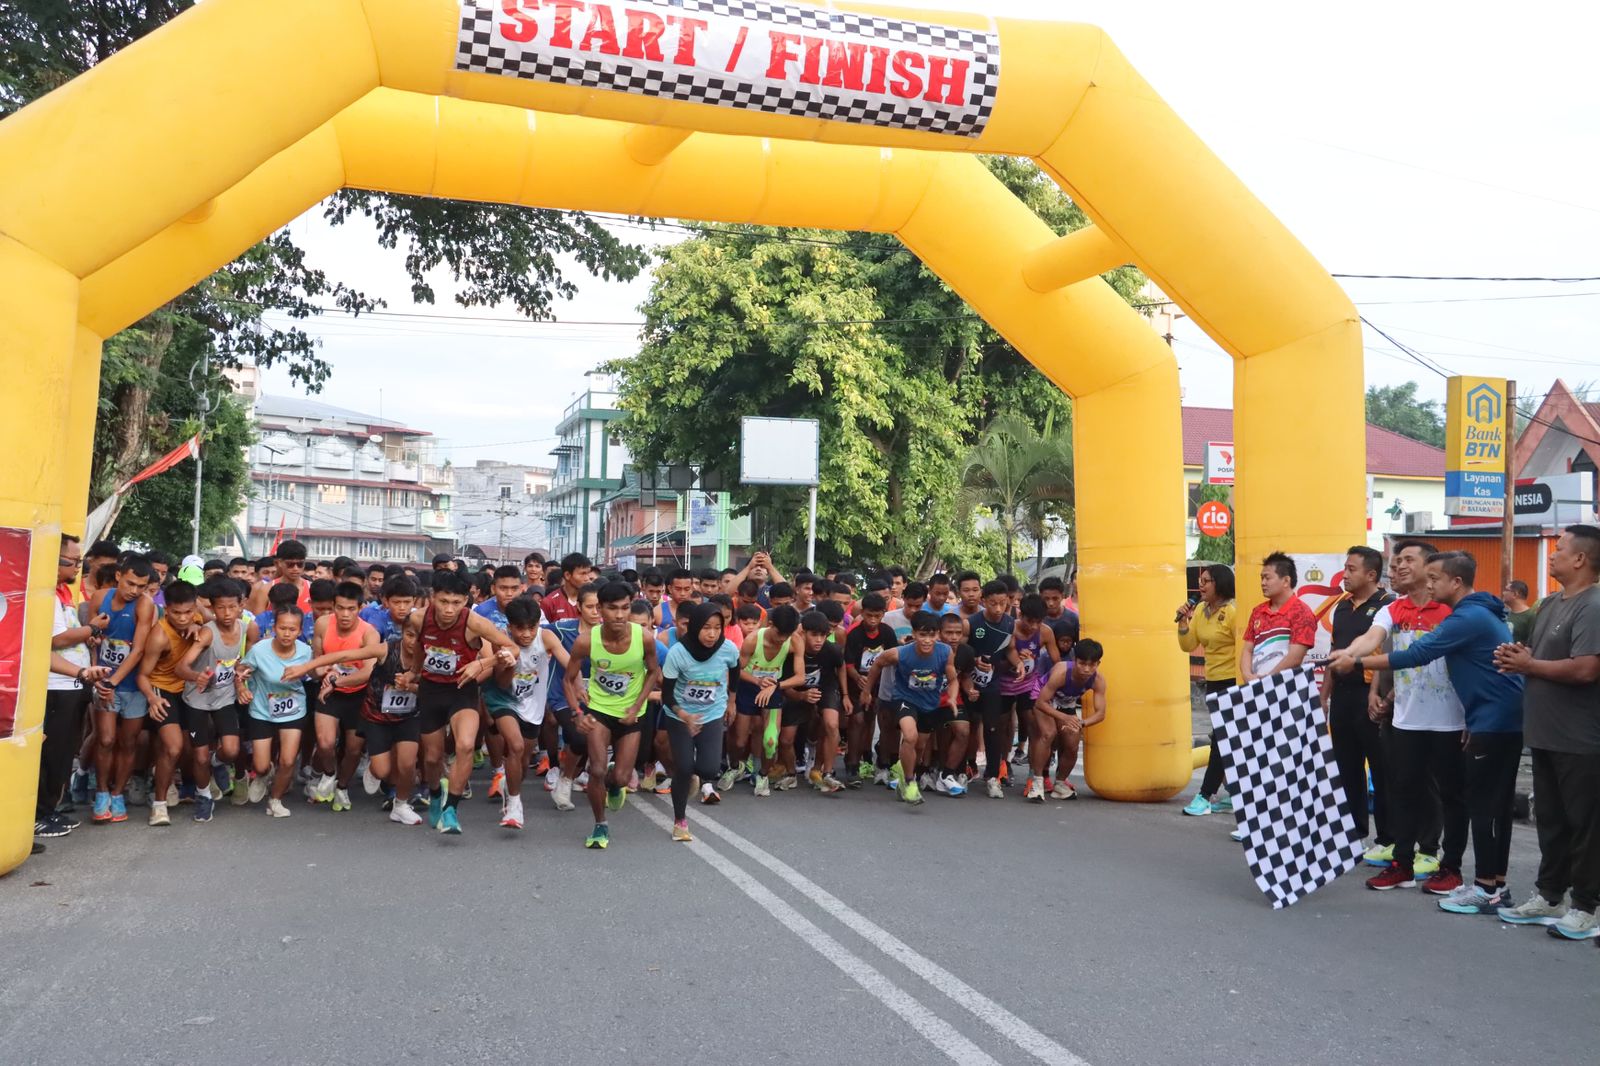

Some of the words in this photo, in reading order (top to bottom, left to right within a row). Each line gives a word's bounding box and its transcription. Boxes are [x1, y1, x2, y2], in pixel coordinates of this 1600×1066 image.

[499, 0, 708, 66] START
[725, 26, 749, 72] /
[765, 30, 970, 106] FINISH
[1465, 426, 1502, 441] Bank
[1465, 442, 1501, 458] BTN
[1464, 472, 1502, 484] Layanan
[1474, 487, 1491, 496] Kas
[1514, 493, 1543, 506] NESIA
[1202, 506, 1228, 524] ria
[104, 649, 125, 663] 359
[427, 657, 451, 670] 056
[599, 675, 624, 691] 069
[390, 695, 409, 706] 101
[688, 688, 712, 700] 357
[273, 698, 293, 713] 390
